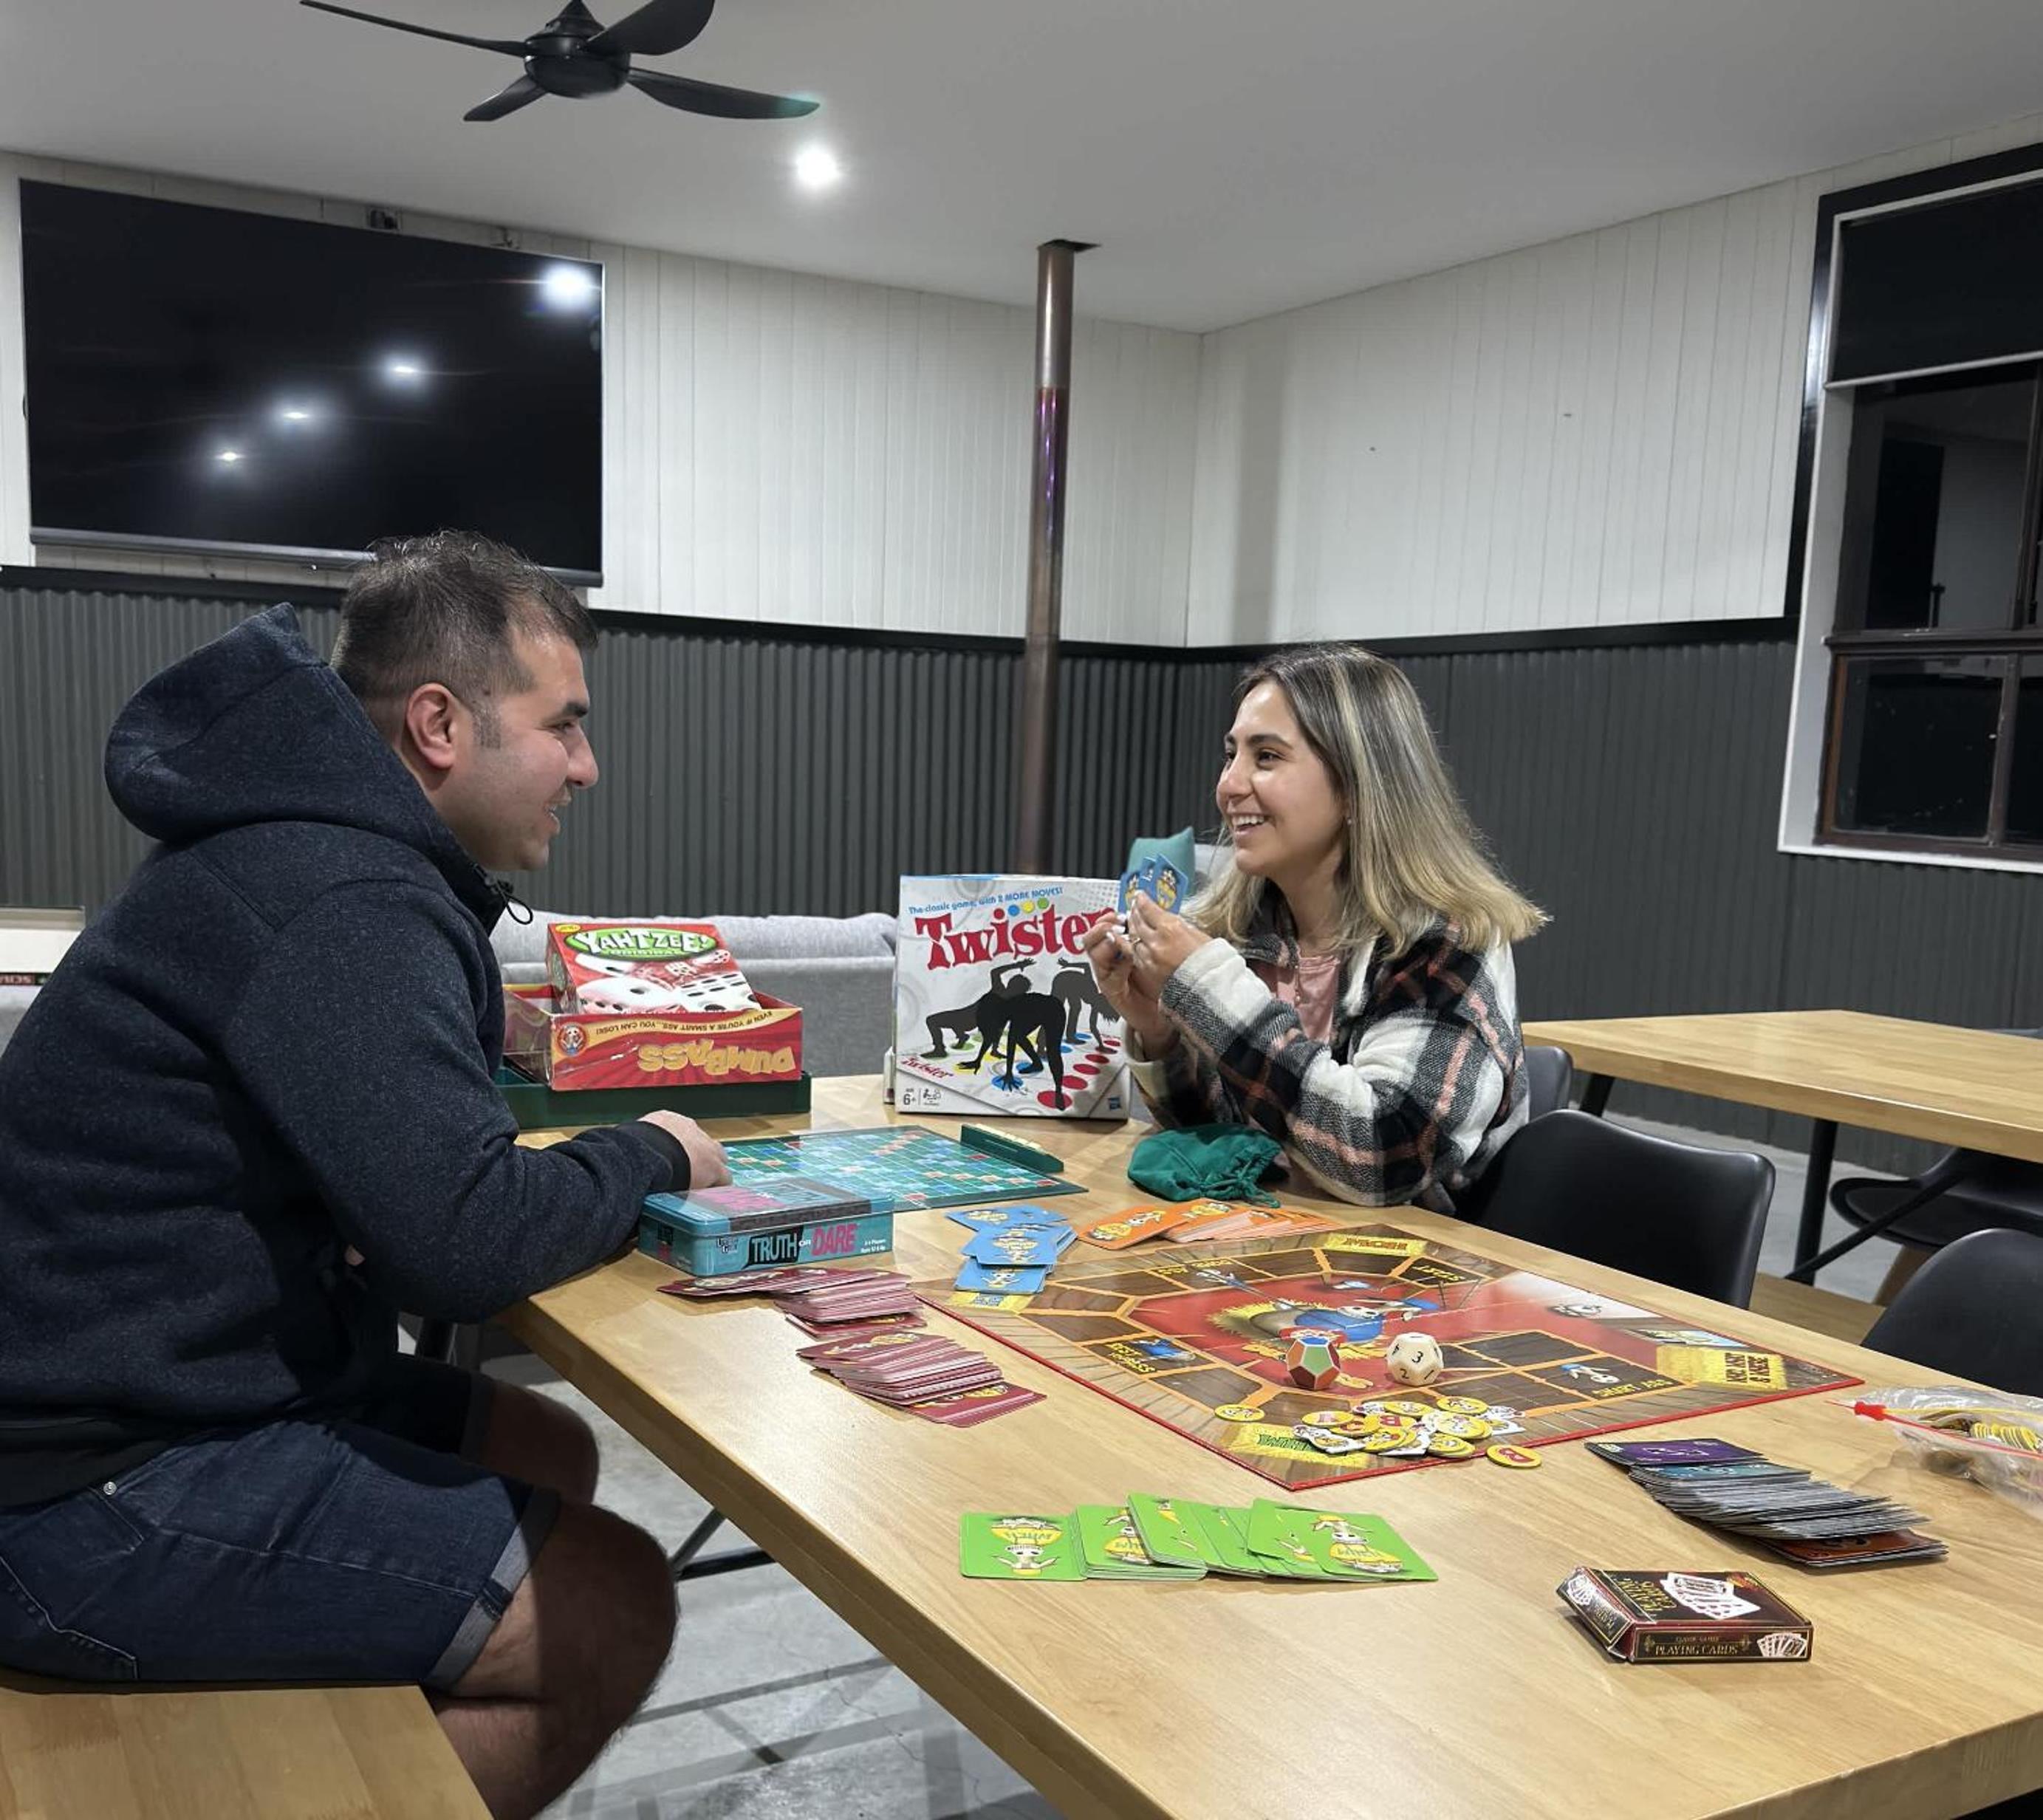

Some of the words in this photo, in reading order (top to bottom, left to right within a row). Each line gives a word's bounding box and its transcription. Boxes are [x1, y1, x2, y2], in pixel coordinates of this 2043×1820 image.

[908, 906, 923, 914] The
[925, 901, 950, 913] classic
[979, 896, 996, 906] with
[1005, 892, 1030, 901] MORE
[753, 1010, 773, 1022] EVEN
[620, 1022, 639, 1031] CAN
[637, 1039, 796, 1075] DUMBASS
[903, 1093, 917, 1106] 6+
[751, 1232, 798, 1263] TRUTH
[812, 1222, 858, 1256] DARE
[1411, 1350, 1424, 1364] 3
[1400, 1367, 1410, 1380] 2
[1654, 1644, 1700, 1657] PLAYING
[1701, 1644, 1739, 1656] CARDS
